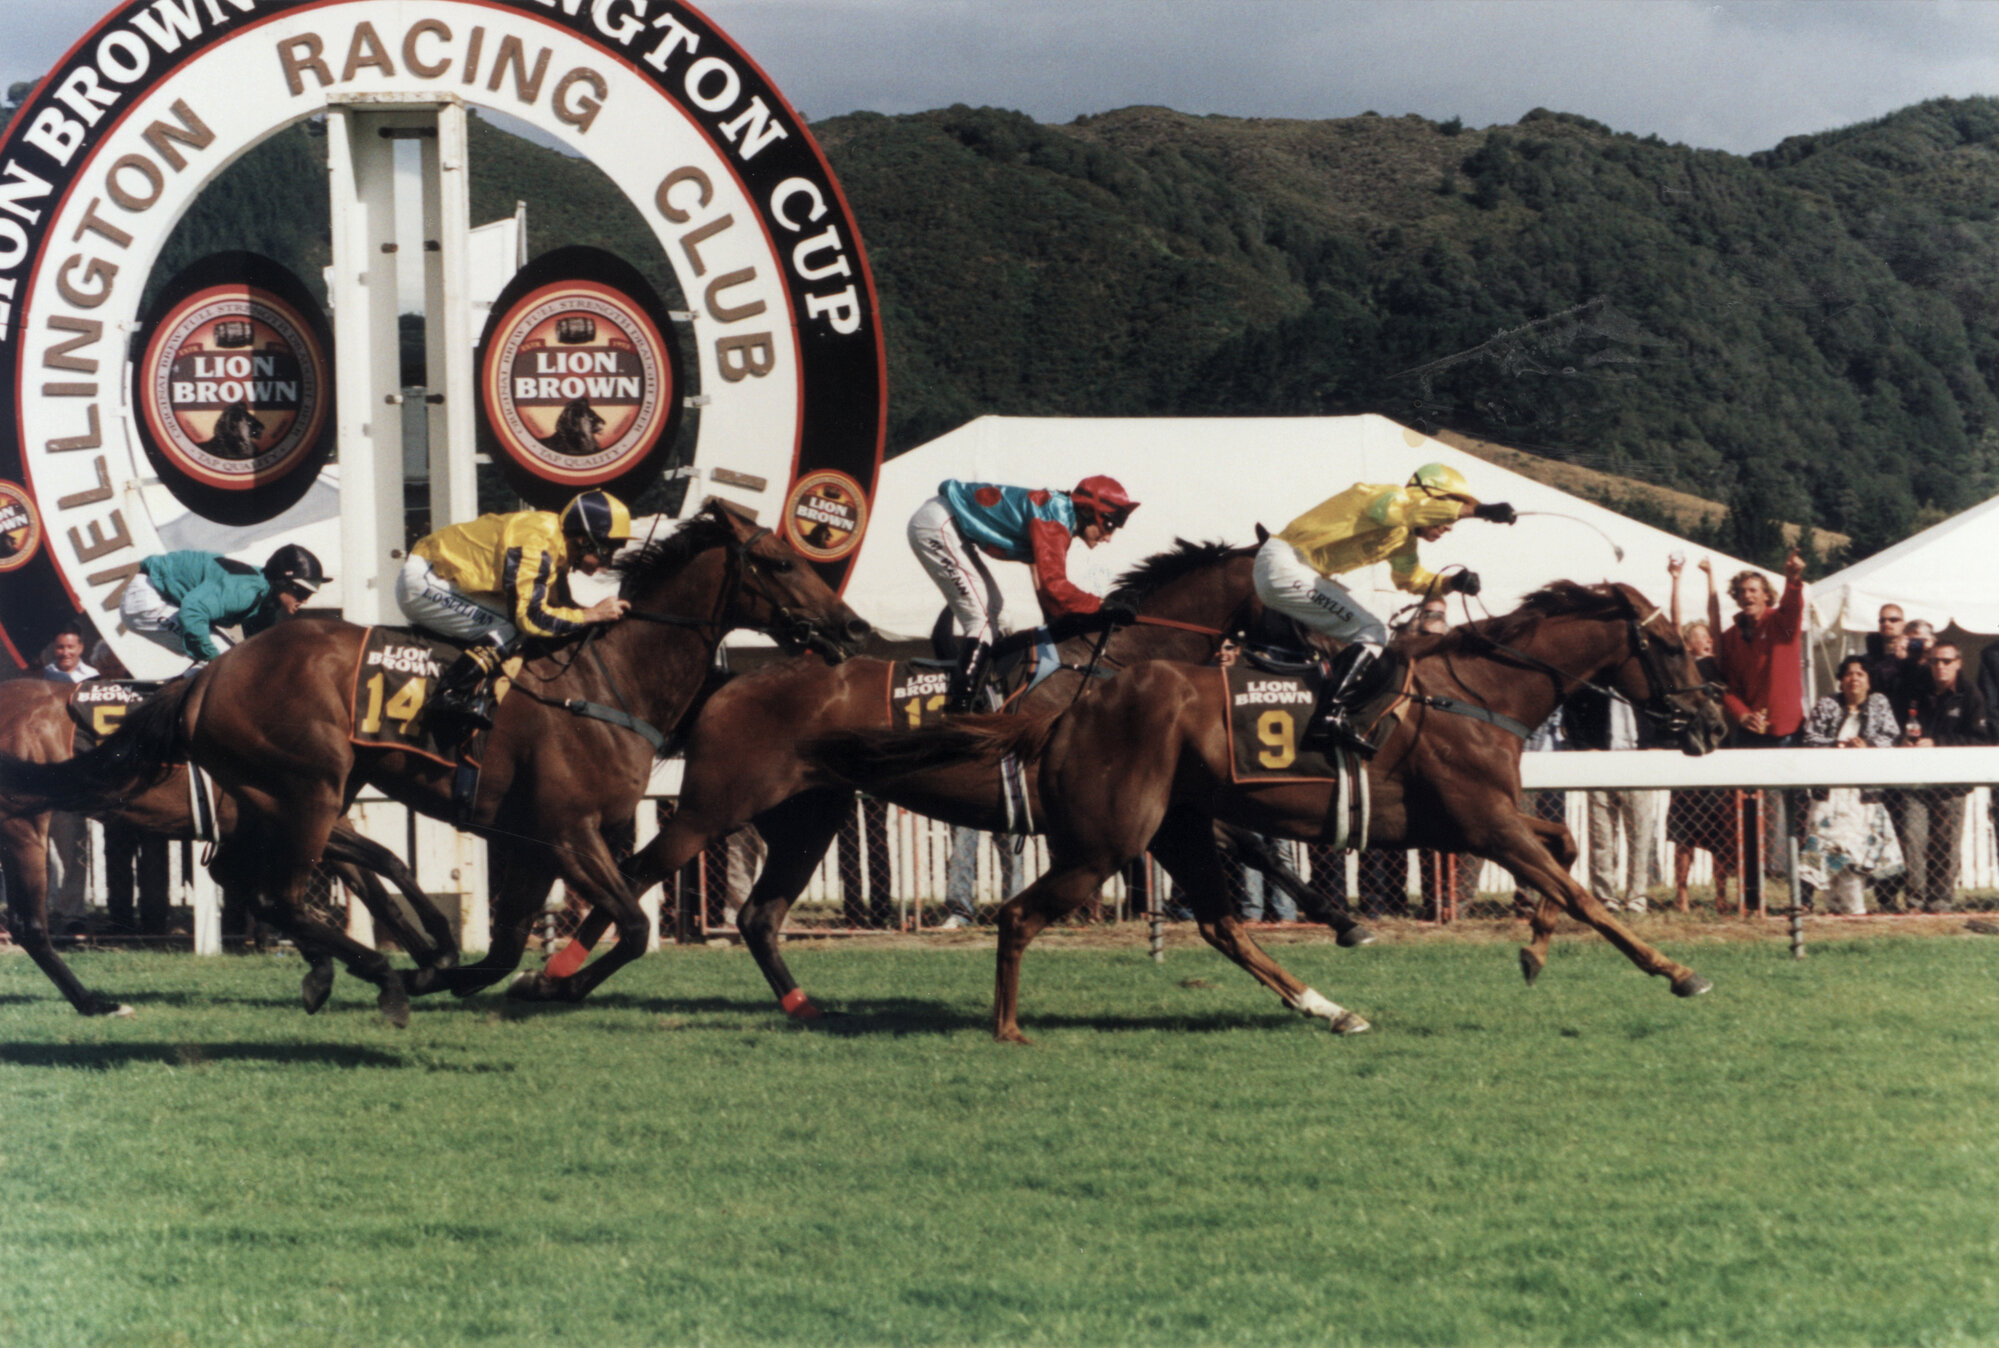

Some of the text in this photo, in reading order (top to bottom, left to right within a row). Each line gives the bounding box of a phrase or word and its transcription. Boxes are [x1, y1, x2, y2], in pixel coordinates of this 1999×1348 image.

[276, 19, 608, 134] RACING
[655, 165, 776, 383] CLUB
[770, 177, 861, 334] CUP
[194, 356, 274, 378] LION
[536, 352, 618, 374] LION
[172, 381, 298, 404] BROWN
[515, 376, 641, 399] BROWN
[796, 504, 855, 531] BROWN
[809, 496, 848, 517] LION
[1306, 588, 1354, 622] GRYLLS
[367, 651, 441, 678] BROWN
[384, 645, 432, 661] LION
[894, 682, 948, 699] BROW
[1234, 689, 1313, 706] BROWN
[1247, 680, 1298, 692] LION
[361, 672, 427, 734] 14
[1257, 710, 1296, 769] 9
